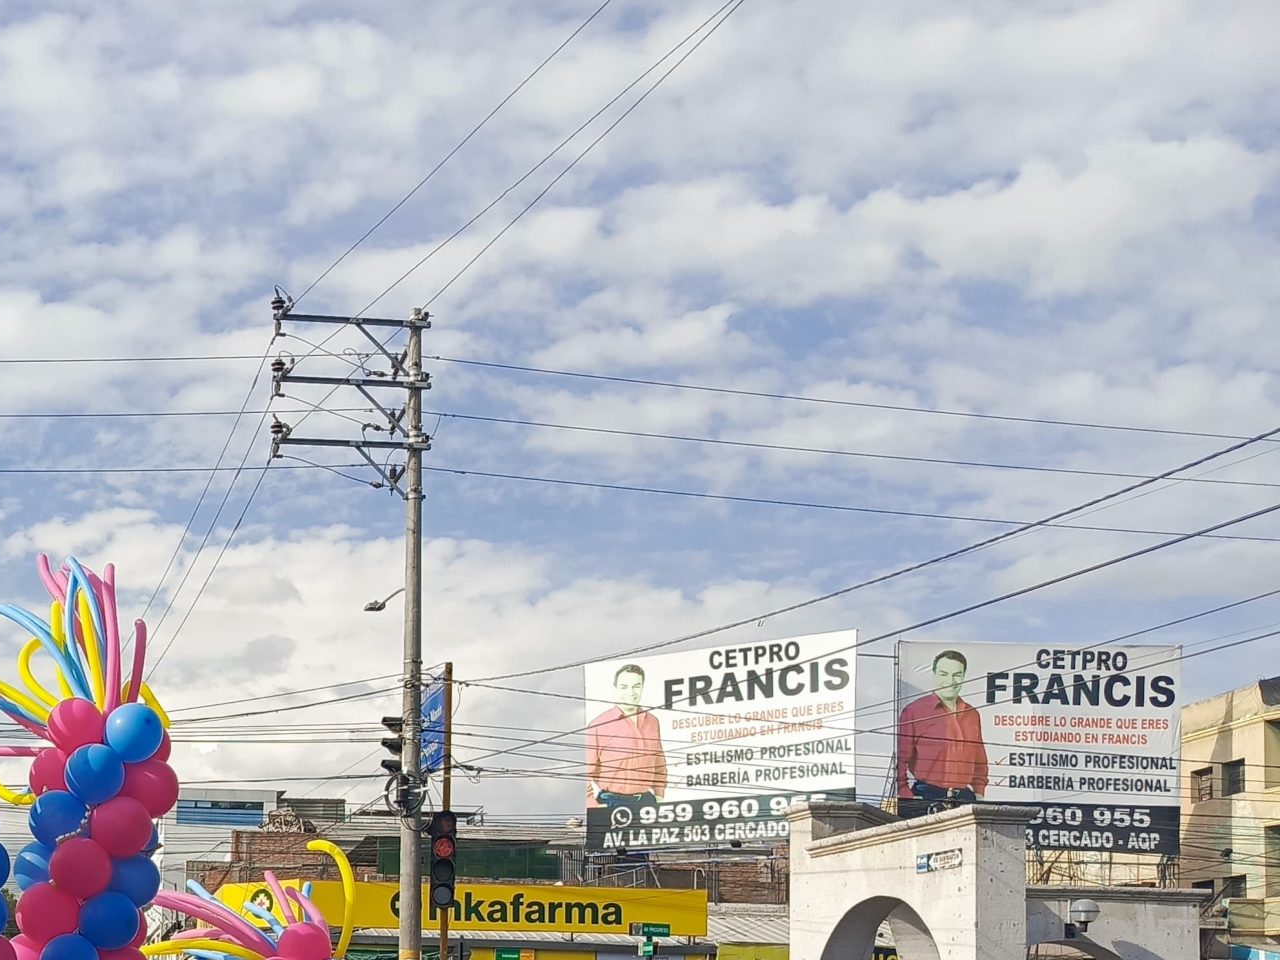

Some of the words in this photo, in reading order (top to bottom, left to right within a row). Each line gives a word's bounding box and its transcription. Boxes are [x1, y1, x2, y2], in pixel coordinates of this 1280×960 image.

[708, 641, 801, 670] CETPRO
[1036, 648, 1128, 672] CETPRO
[663, 657, 850, 710] FRANCIS
[985, 671, 1176, 708] FRANCIS
[672, 714, 725, 731] DESCUBRE
[728, 712, 742, 725] LO
[745, 706, 788, 723] GRANDE
[791, 704, 814, 718] QUE
[816, 701, 844, 716] ERES
[993, 714, 1051, 728] DESCUBRE
[1054, 716, 1068, 728] LO
[1070, 716, 1113, 730] GRANDE
[1115, 718, 1138, 731] QUE
[1141, 718, 1169, 731] ERES
[690, 726, 757, 744] ESTUDIANDO
[760, 724, 774, 738] EN
[776, 718, 824, 736] FRANCIS
[1014, 730, 1082, 744] ESTUDIANDO
[1085, 732, 1099, 745] EN
[1101, 732, 1148, 746] FRANCIS
[686, 747, 754, 767] ESTILISMO
[760, 737, 851, 761] PROFESIONAL
[1008, 752, 1079, 769] ESTILISMO
[1084, 754, 1177, 771] PROFESIONAL
[686, 766, 750, 788] BARBERÍA
[755, 761, 847, 784] PROFESIONAL
[1008, 772, 1075, 791] BARBERÍA
[1079, 776, 1171, 793] PROFESIONAL
[639, 802, 693, 825] 959
[702, 798, 759, 820] 960
[1092, 806, 1152, 828] 955
[602, 831, 625, 849] AV.
[628, 828, 648, 847] LA
[651, 826, 680, 845] PAZ
[683, 824, 711, 842] 503
[714, 821, 790, 841] CERCADO
[1038, 829, 1114, 849] CERCADO
[1128, 831, 1160, 851] AQP
